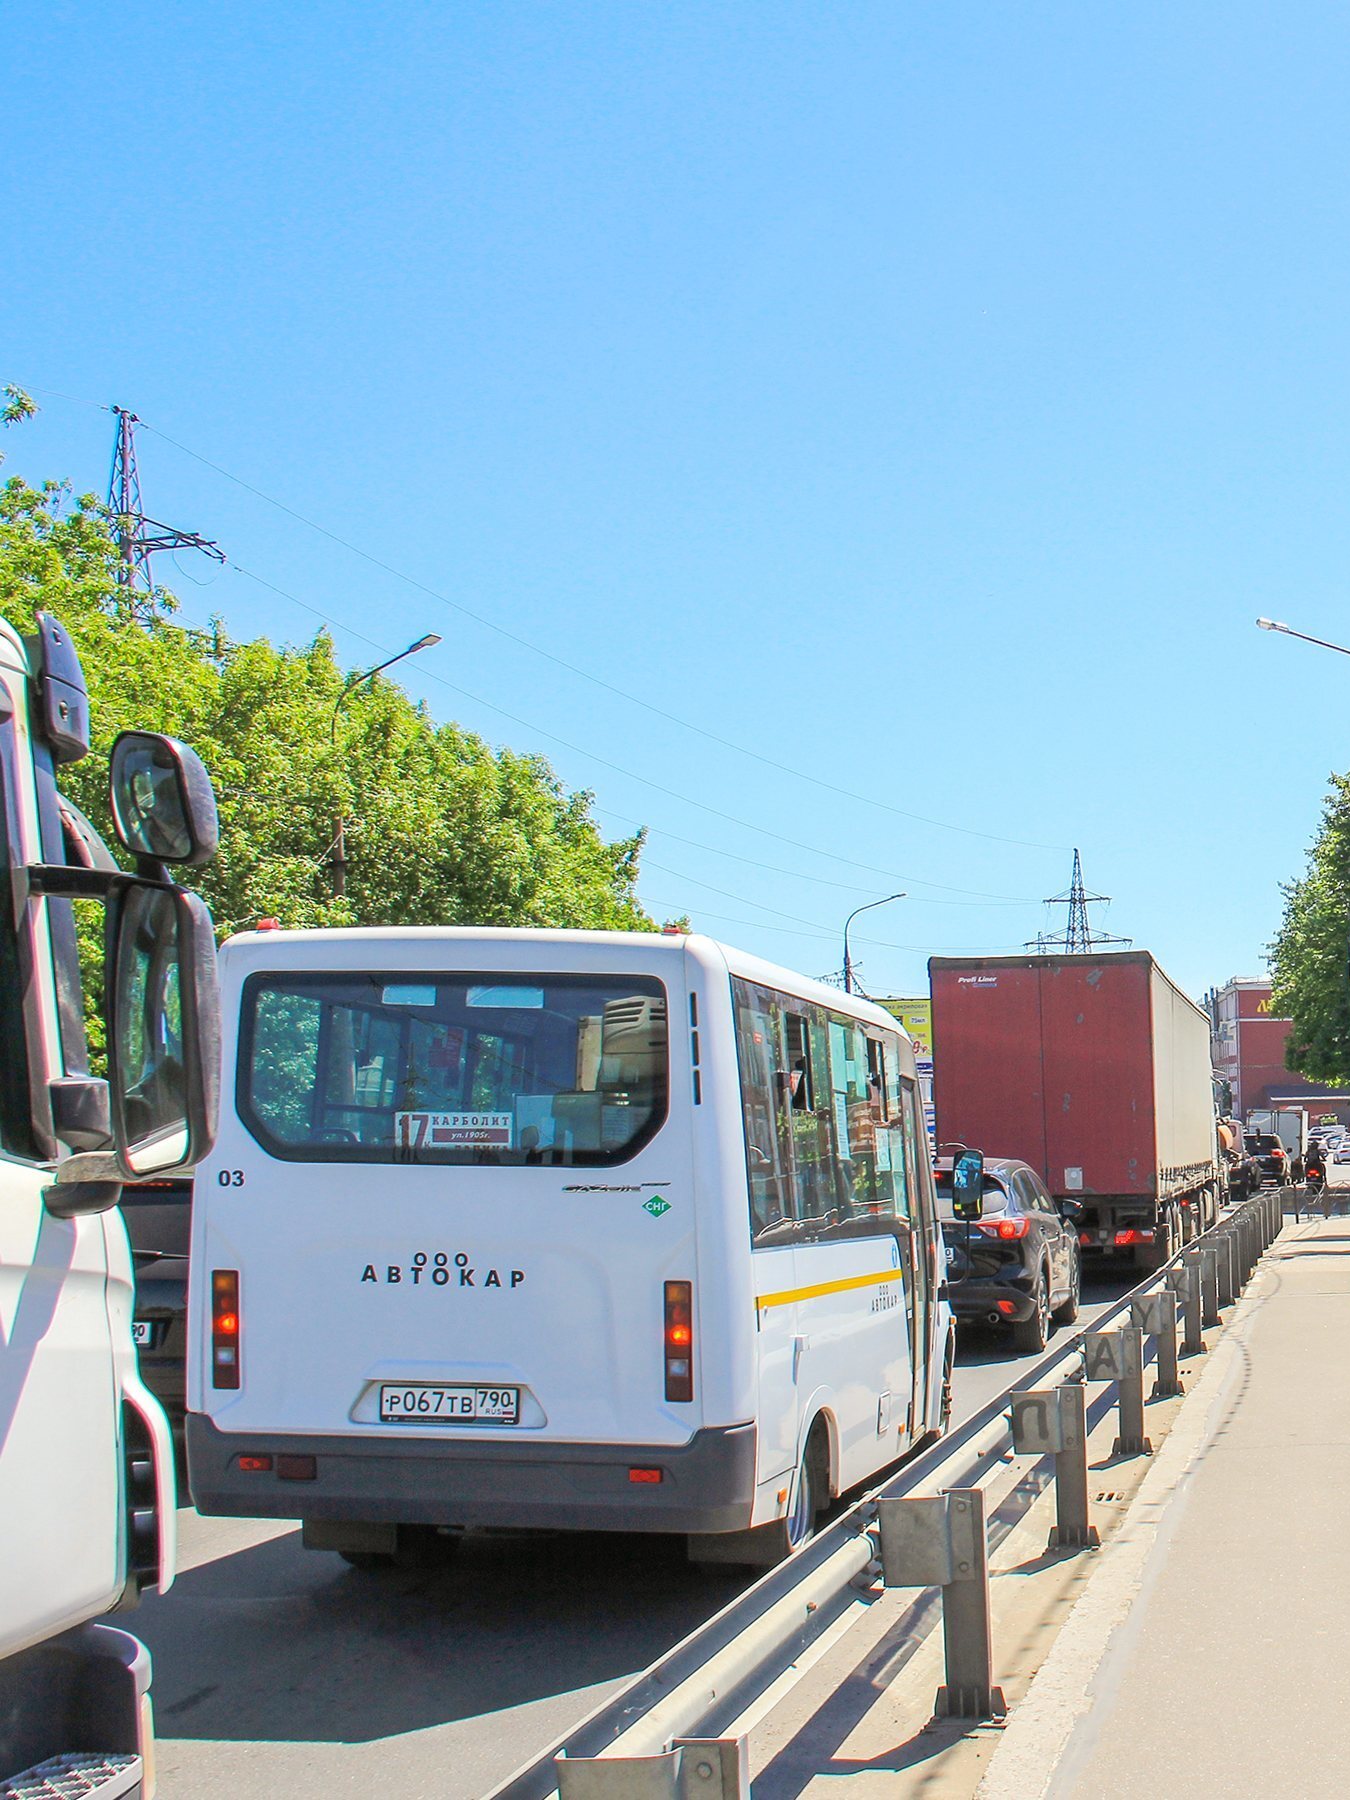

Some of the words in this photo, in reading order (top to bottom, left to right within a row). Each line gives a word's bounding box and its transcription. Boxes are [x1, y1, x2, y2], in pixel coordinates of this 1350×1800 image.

[398, 1114, 430, 1150] 17
[432, 1116, 510, 1126] КАРБОЛИТ
[218, 1170, 245, 1187] 03
[645, 1201, 667, 1211] СНГ
[413, 1252, 468, 1267] ООО
[360, 1264, 525, 1288] АВТОКАР
[388, 1390, 473, 1414] Р067ТВ
[478, 1390, 511, 1408] 790
